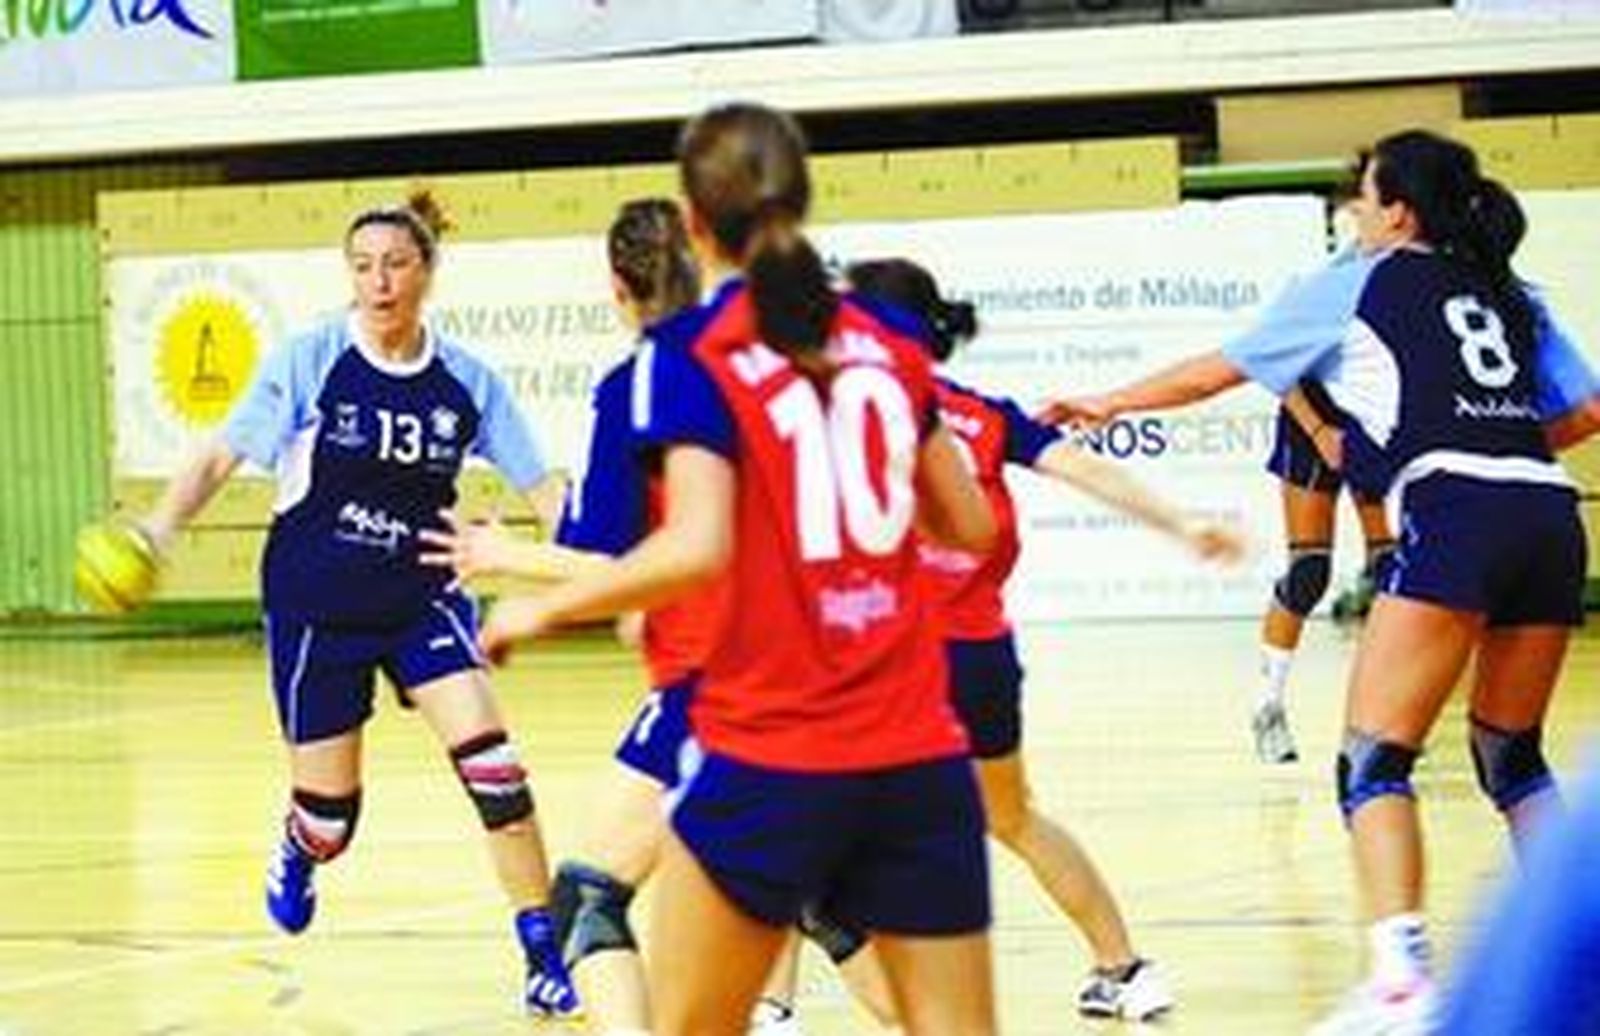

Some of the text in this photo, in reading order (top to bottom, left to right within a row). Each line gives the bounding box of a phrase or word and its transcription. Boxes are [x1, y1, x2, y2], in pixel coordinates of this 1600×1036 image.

[1092, 279, 1134, 312] de
[1443, 294, 1519, 388] 8
[376, 410, 423, 464] 13
[764, 364, 918, 562] 10
